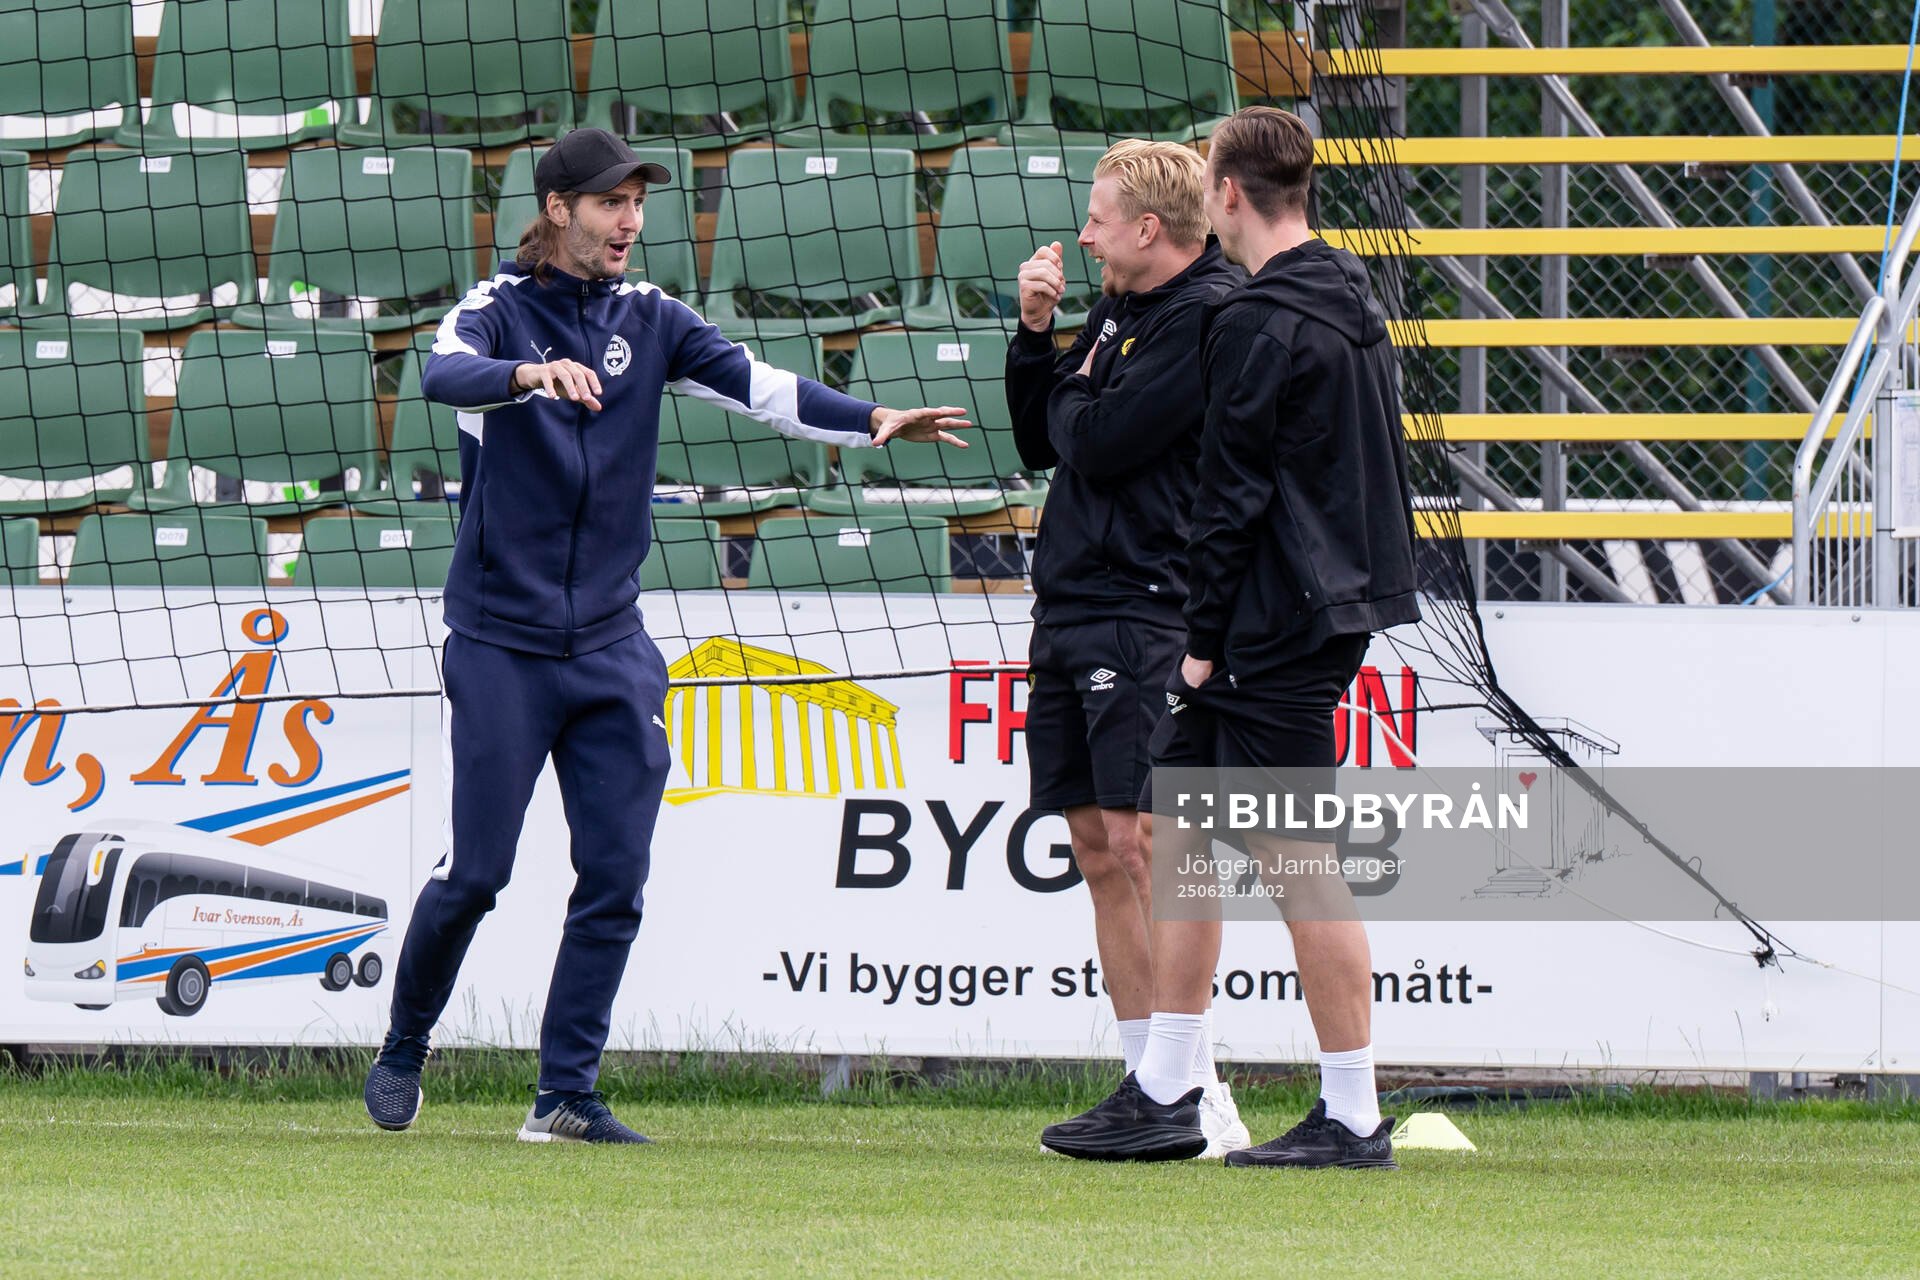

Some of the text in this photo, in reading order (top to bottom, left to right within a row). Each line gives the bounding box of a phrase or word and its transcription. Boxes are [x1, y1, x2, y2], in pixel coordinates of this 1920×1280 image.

[130, 608, 334, 788] Ås
[1090, 682, 1114, 691] umbro
[192, 905, 304, 929] Ivar Svensson, Ås
[763, 951, 827, 993] -Vi
[850, 952, 1034, 1007] bygger
